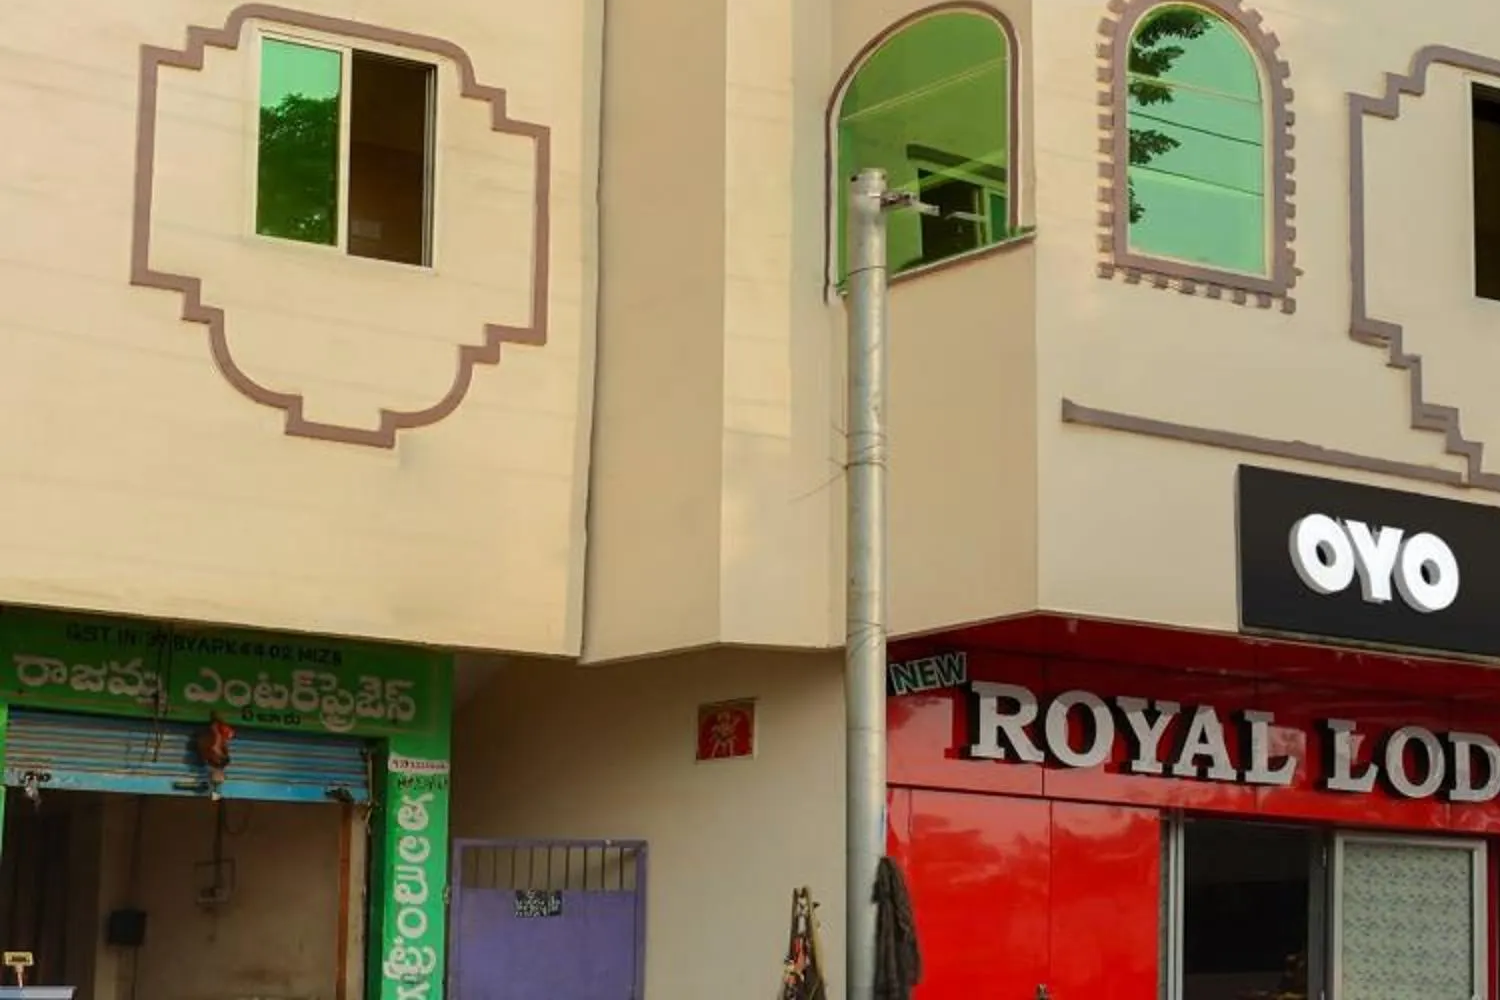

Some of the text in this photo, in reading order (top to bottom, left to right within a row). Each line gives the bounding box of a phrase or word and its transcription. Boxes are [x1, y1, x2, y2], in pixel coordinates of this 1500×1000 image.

[1289, 511, 1460, 613] OYO
[889, 651, 967, 696] NEW
[969, 680, 1302, 787] ROYAL
